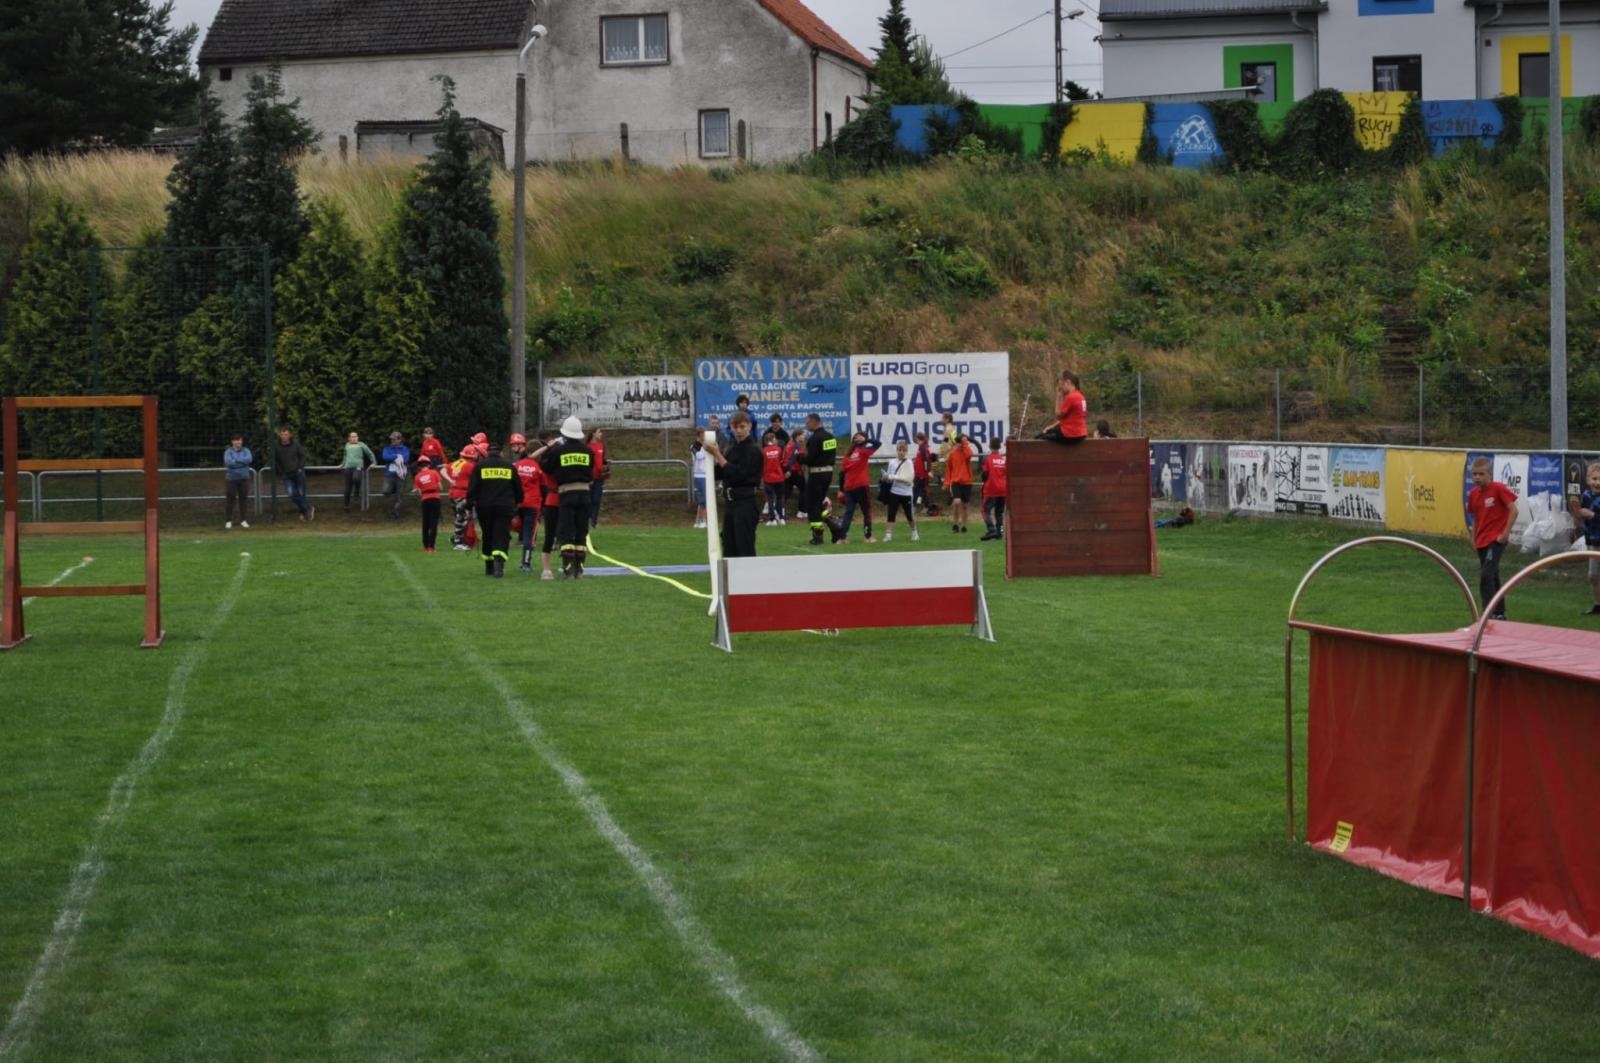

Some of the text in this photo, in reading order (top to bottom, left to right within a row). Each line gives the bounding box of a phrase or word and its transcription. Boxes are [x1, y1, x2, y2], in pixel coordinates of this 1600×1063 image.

[1359, 117, 1393, 134] RUCH
[698, 358, 848, 381] OKNA DRZWI
[731, 383, 758, 391] OKNA
[761, 382, 807, 390] DACHOWE
[856, 383, 987, 415] PRACA
[856, 422, 883, 444] W
[1413, 483, 1436, 502] InPost
